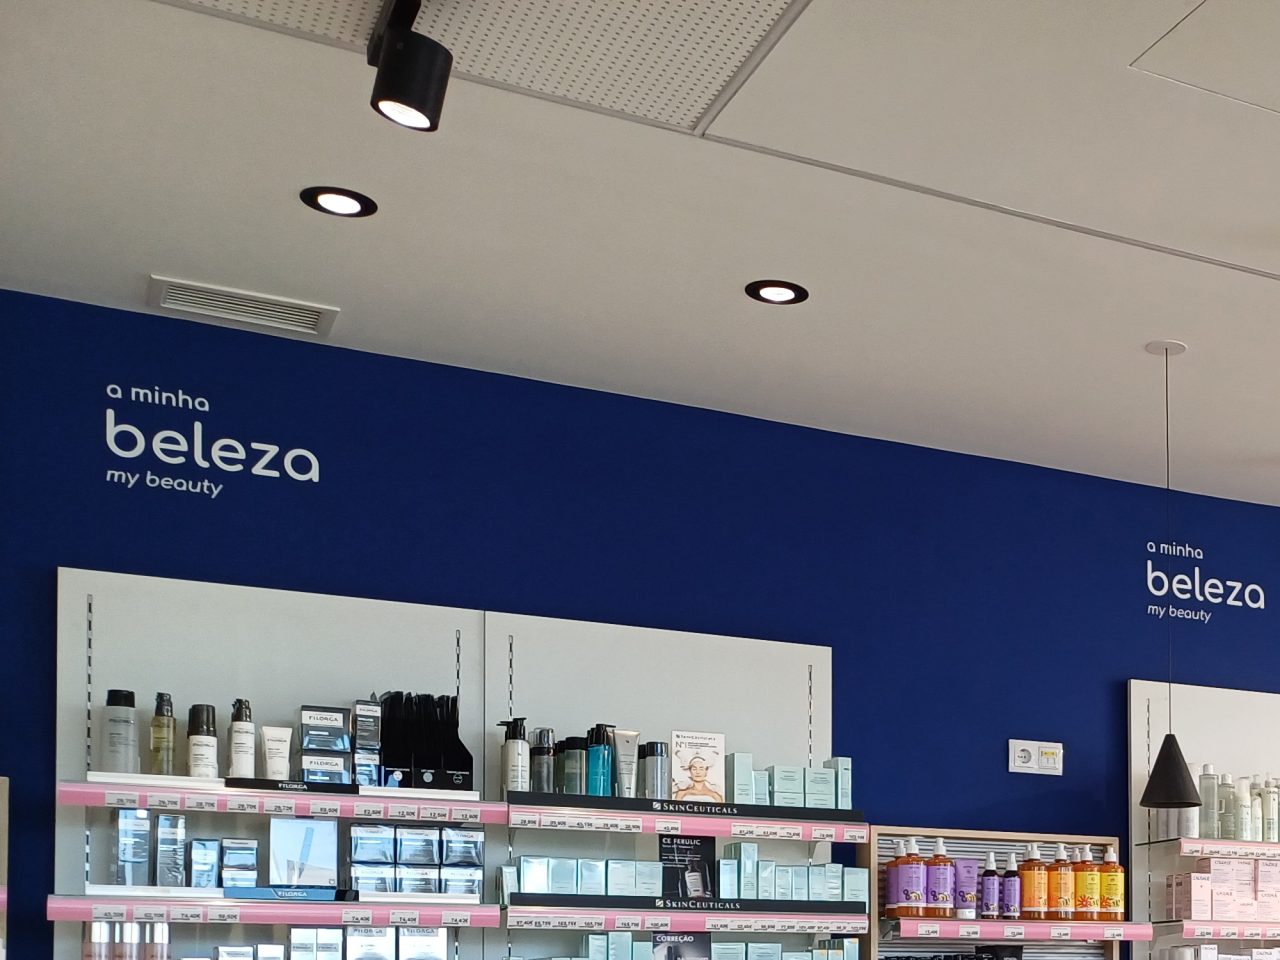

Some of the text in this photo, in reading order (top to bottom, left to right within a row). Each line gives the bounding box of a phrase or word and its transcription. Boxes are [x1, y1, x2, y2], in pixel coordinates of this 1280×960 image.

[106, 384, 209, 412] a minha
[106, 408, 319, 482] beleza
[106, 470, 223, 498] my beauty
[1147, 541, 1203, 559] a minha
[1147, 560, 1265, 609] beleza
[1147, 605, 1212, 624] my beauty
